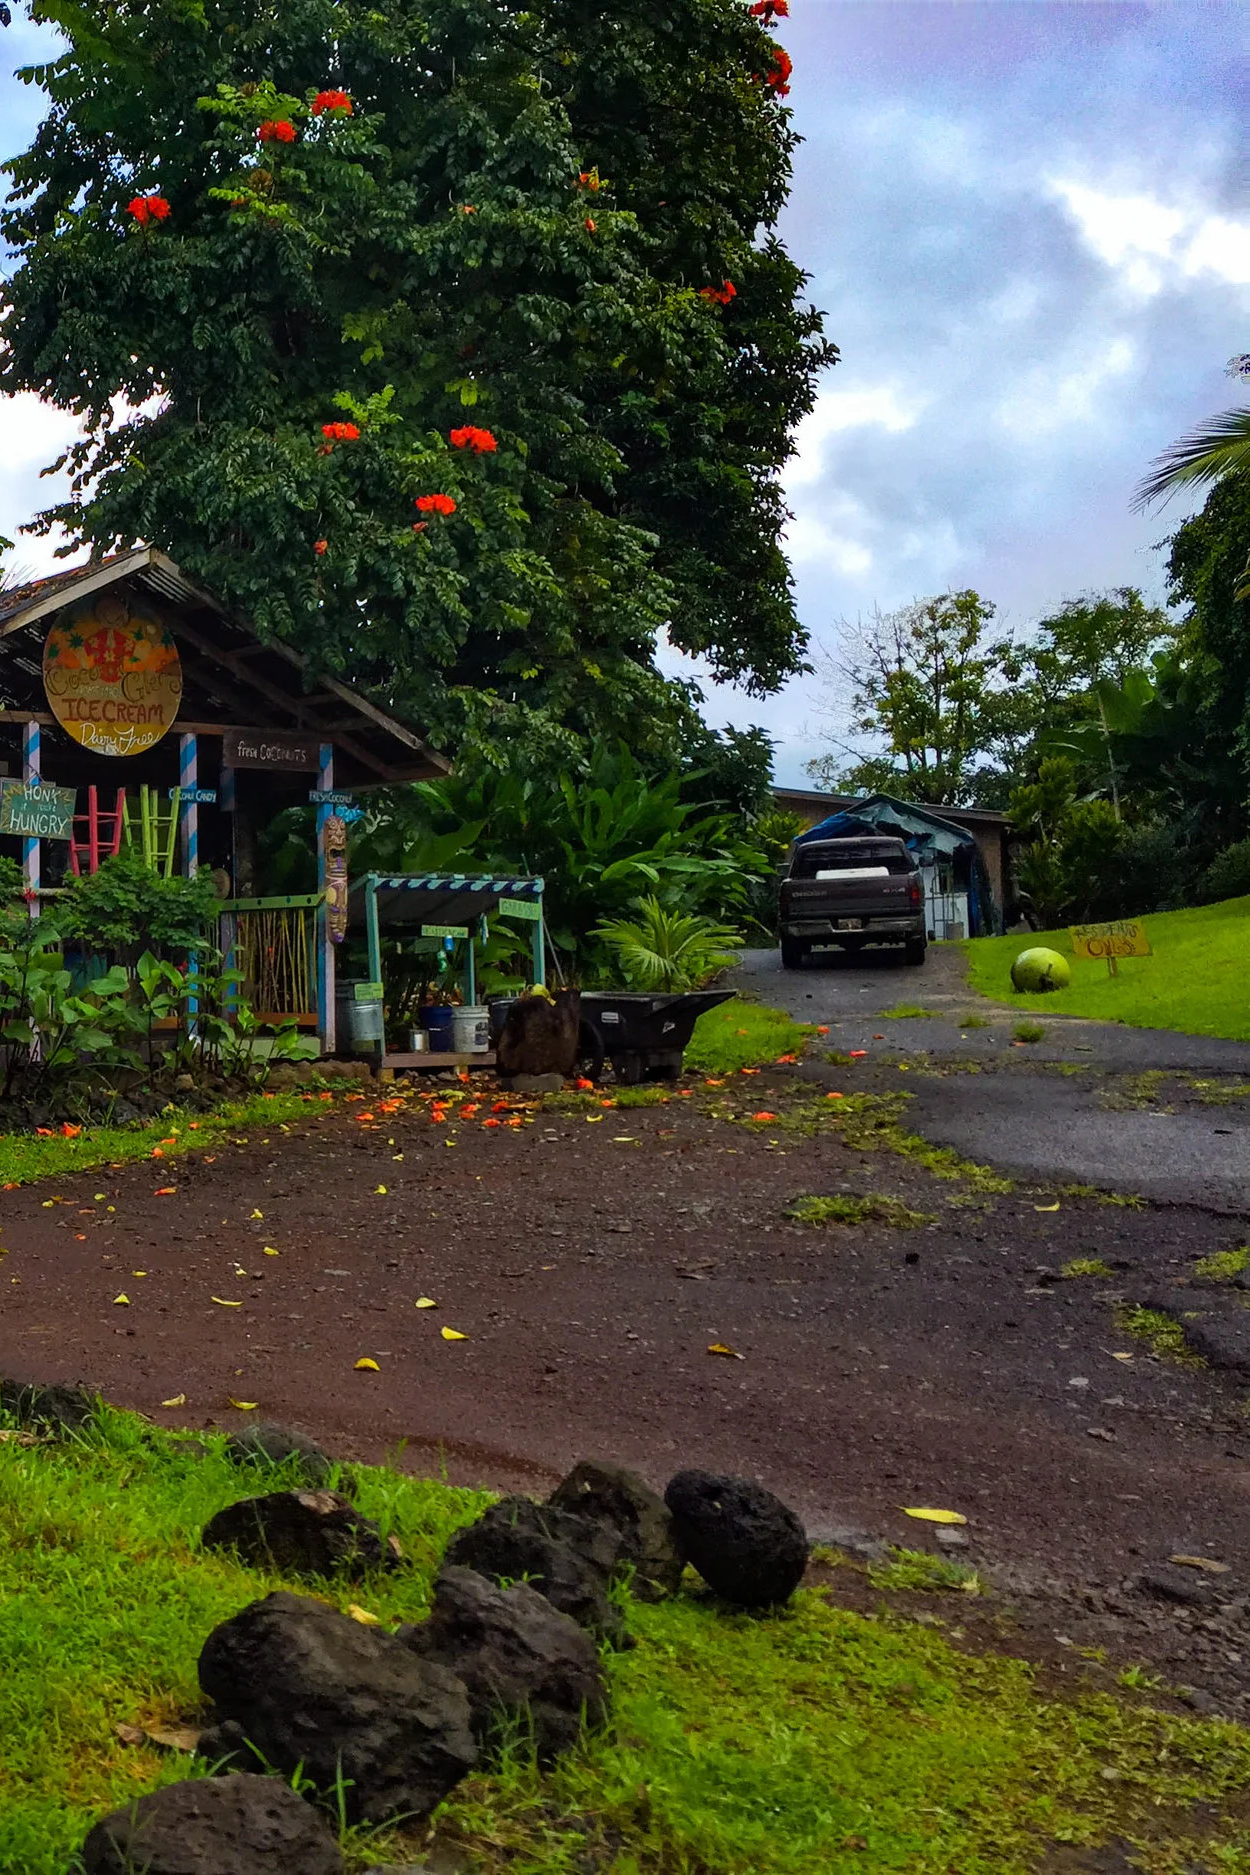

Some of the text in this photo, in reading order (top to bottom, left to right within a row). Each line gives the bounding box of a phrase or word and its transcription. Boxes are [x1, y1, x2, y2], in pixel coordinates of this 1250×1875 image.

[102, 699, 164, 725] CREAM
[80, 723, 161, 754] Dairy Free
[23, 785, 61, 804] HONK
[10, 809, 68, 835] HUNGRY
